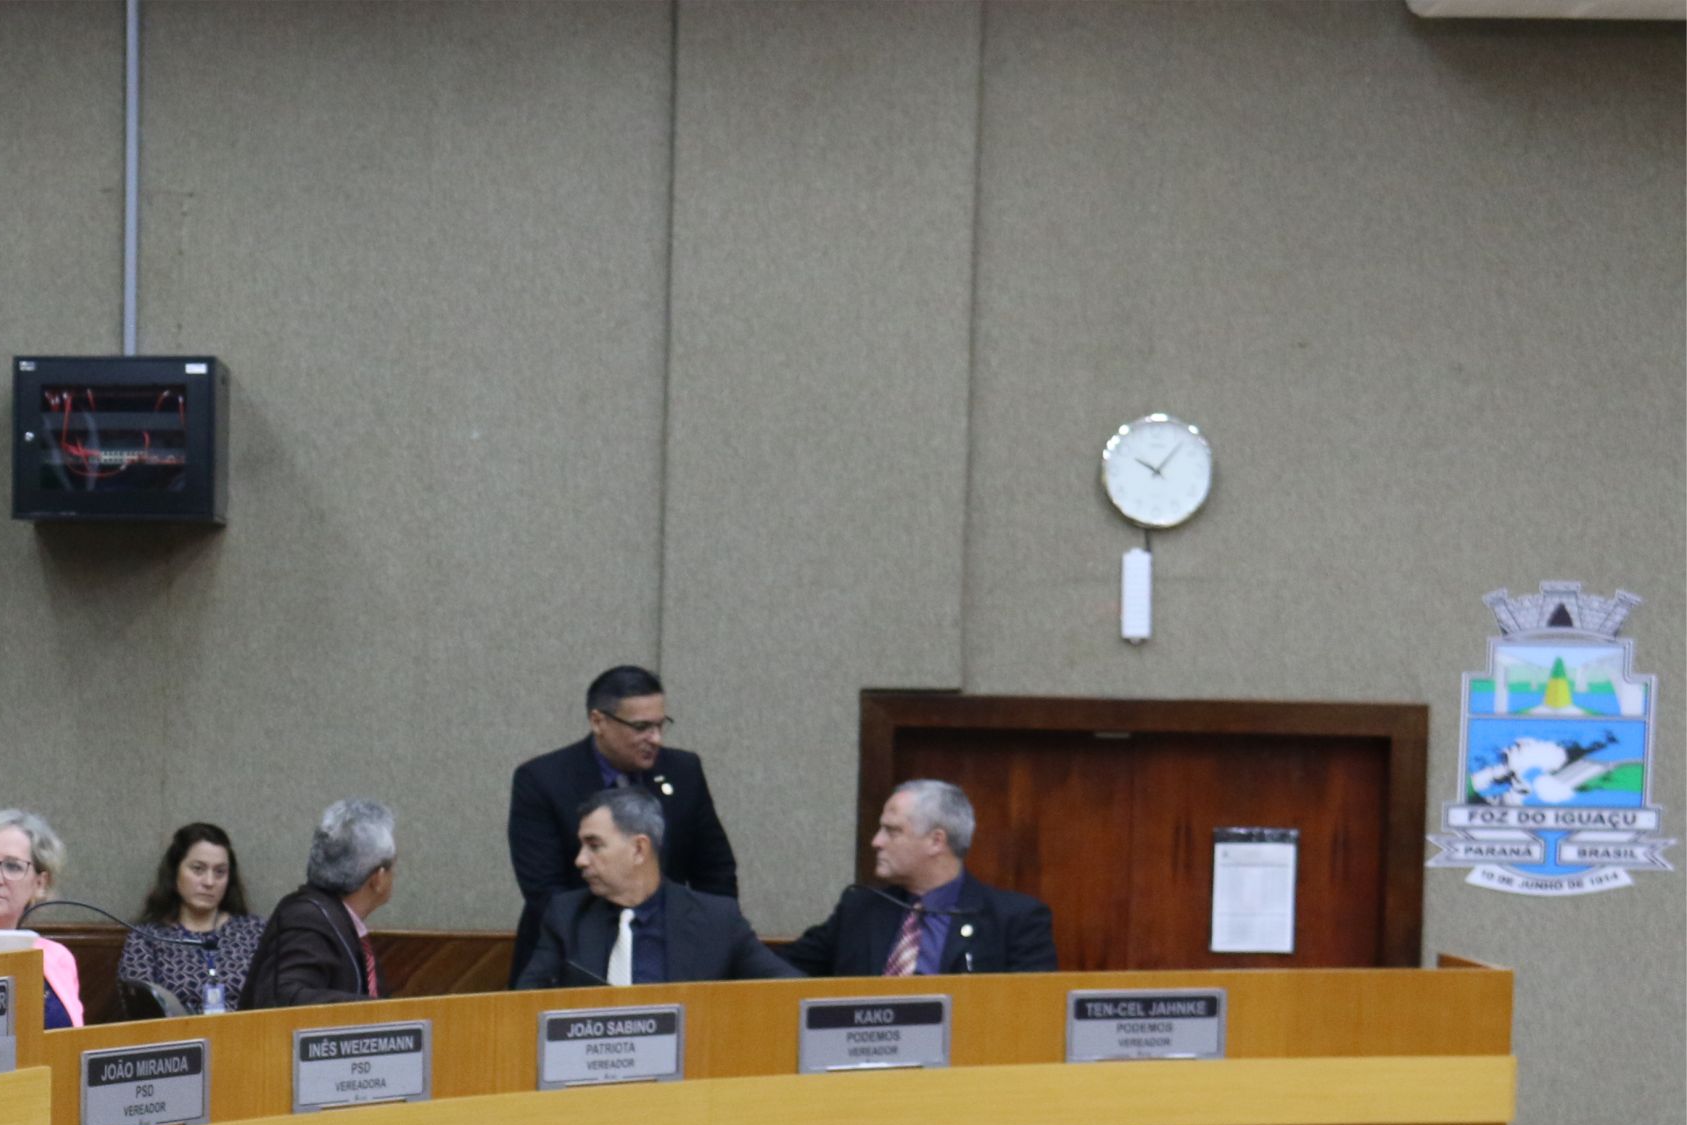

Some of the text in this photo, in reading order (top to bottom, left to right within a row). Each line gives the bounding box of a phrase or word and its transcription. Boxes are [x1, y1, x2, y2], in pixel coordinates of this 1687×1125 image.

[1468, 811, 1637, 829] FOZ DO IGUAÇU
[1464, 842, 1637, 859] PARANÁ BRASIL
[854, 1008, 895, 1024] KAKO
[1148, 1000, 1208, 1016] JAHNKE
[566, 1019, 658, 1038] JOÃO SABINO
[846, 1029, 900, 1043] PODEMOS
[1116, 1022, 1173, 1034] PODEMOS
[308, 1035, 414, 1058] INÊS WEIZEMANN
[585, 1041, 636, 1056] PATRIOTA
[100, 1055, 189, 1082] JOÃO MIRANDA
[350, 1061, 372, 1075] PSD
[587, 1058, 635, 1071] VEREADOR
[135, 1084, 154, 1099] PSD
[334, 1078, 387, 1092] VEREADORA
[123, 1101, 166, 1117] VEREADOR
